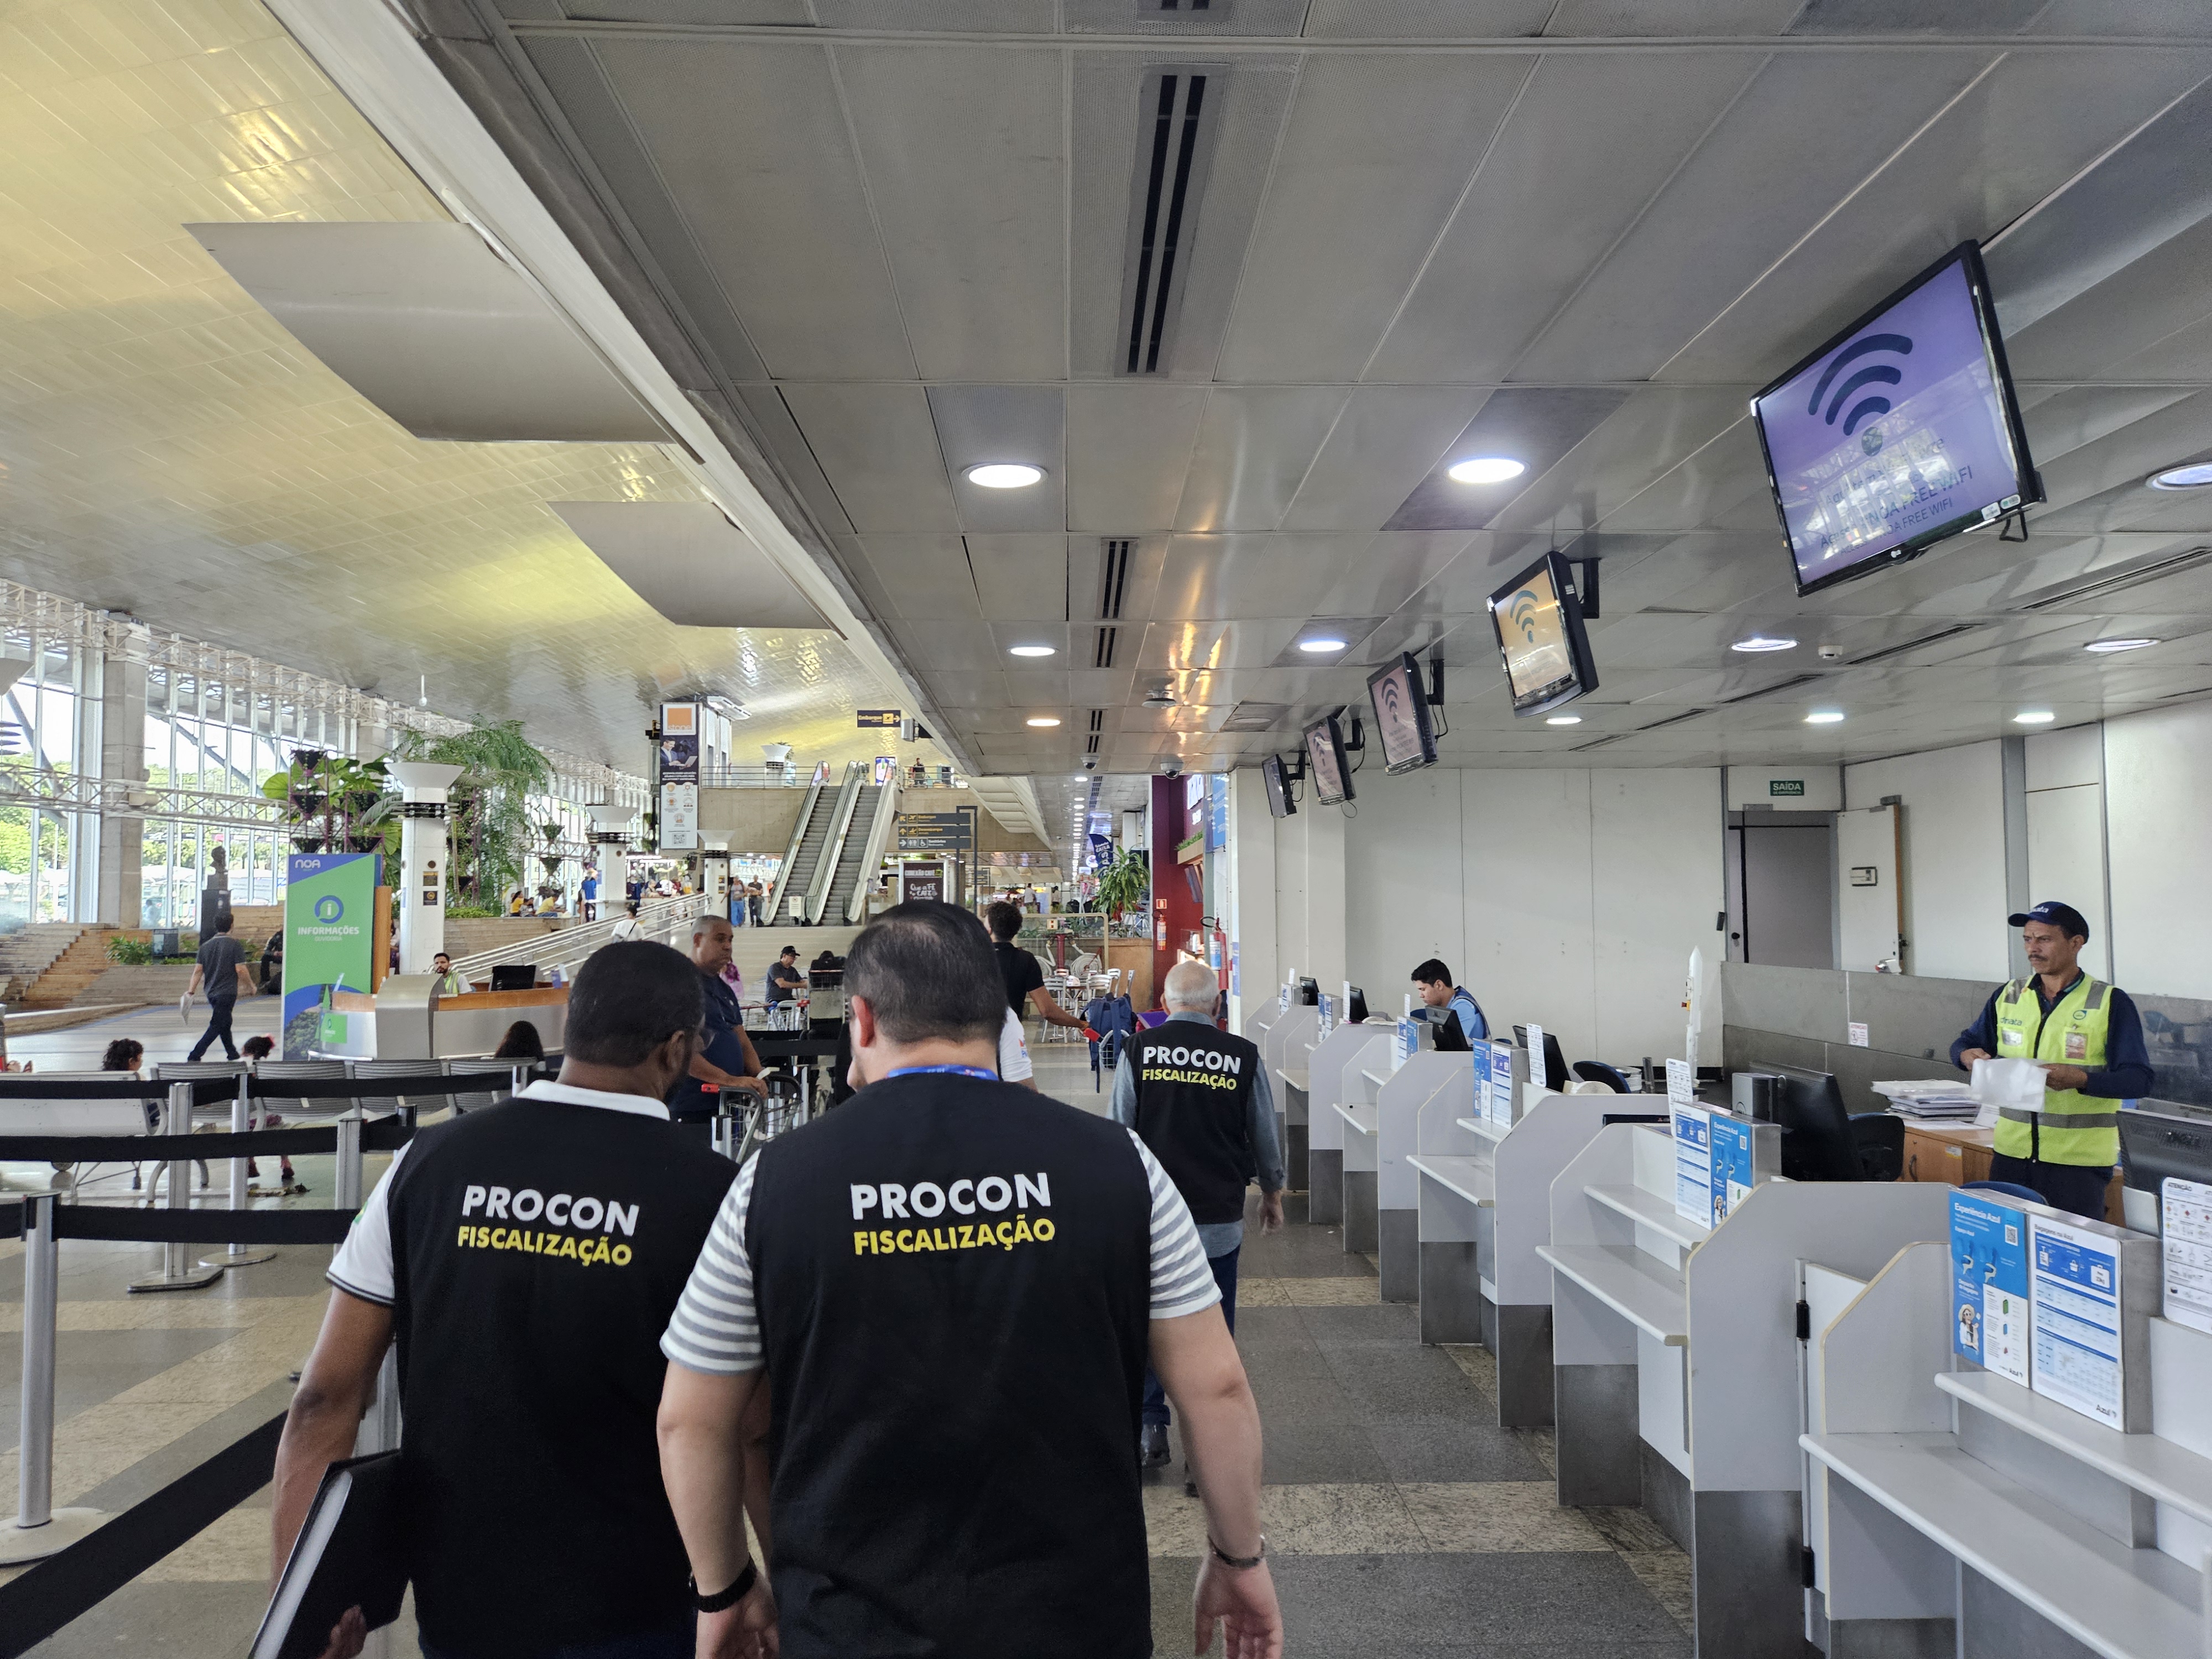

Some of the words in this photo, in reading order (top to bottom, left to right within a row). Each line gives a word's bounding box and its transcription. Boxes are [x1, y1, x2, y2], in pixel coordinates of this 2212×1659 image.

[1902, 508, 1928, 528] FREE
[1929, 498, 1952, 515] WIFI
[1773, 781, 1801, 790] SAÍDA
[298, 925, 359, 936] INFORMAÇÕES
[2000, 1016, 2022, 1026] dnata
[1143, 1045, 1240, 1074] PROCON
[1142, 1069, 1238, 1091] FISCALIZAÇÃO
[851, 1172, 1051, 1220] PROCON
[462, 1185, 639, 1237] PROCON
[1987, 1213, 2001, 1224] Azul
[458, 1226, 632, 1266] FISCALIZAÇÃO
[854, 1214, 1055, 1255] FISCALIZAÇÃO
[2096, 1404, 2110, 1416] Azul
